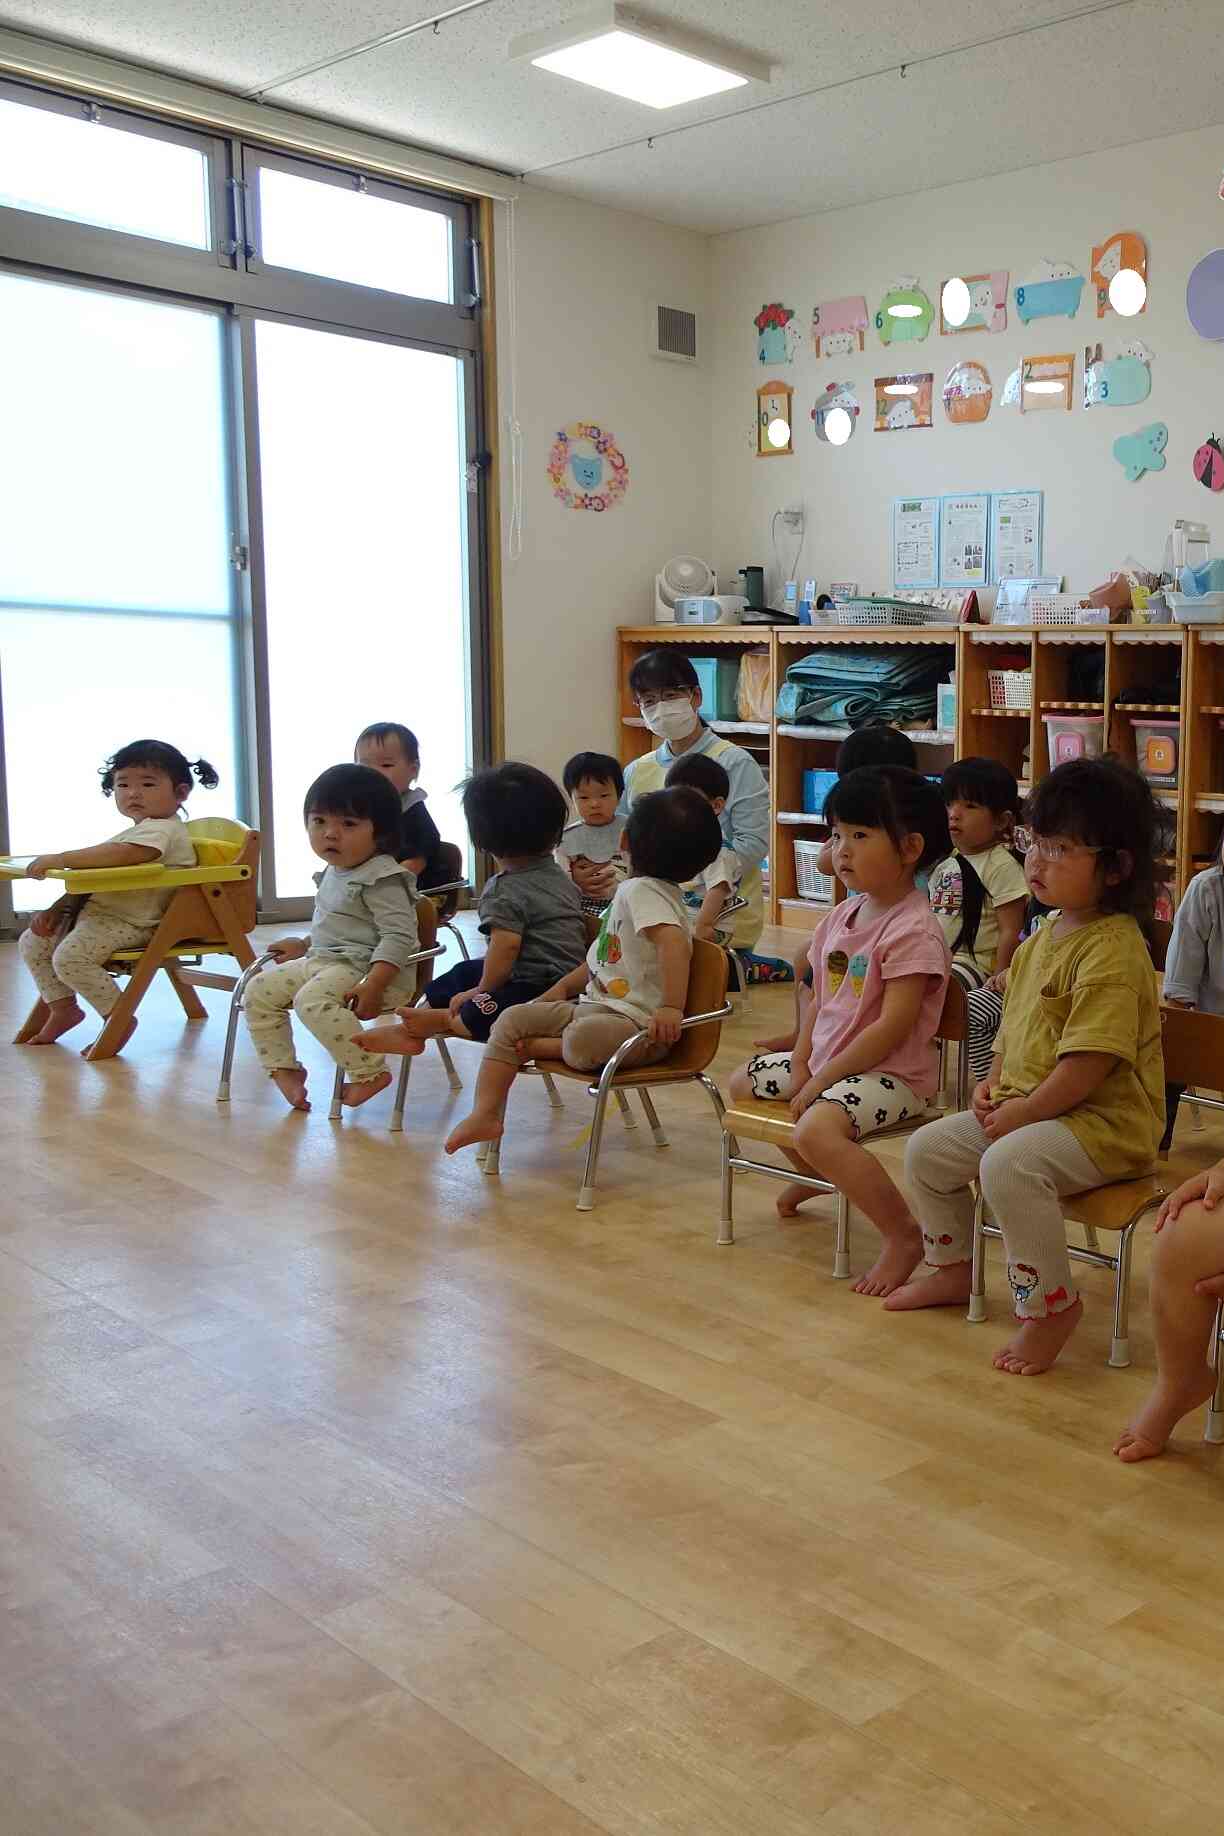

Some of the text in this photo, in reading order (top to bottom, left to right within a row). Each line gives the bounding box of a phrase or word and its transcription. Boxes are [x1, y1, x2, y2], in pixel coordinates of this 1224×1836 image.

[1016, 287, 1025, 306] 8
[812, 307, 820, 325] 5
[875, 311, 883, 329] 6
[1100, 381, 1109, 398] 3
